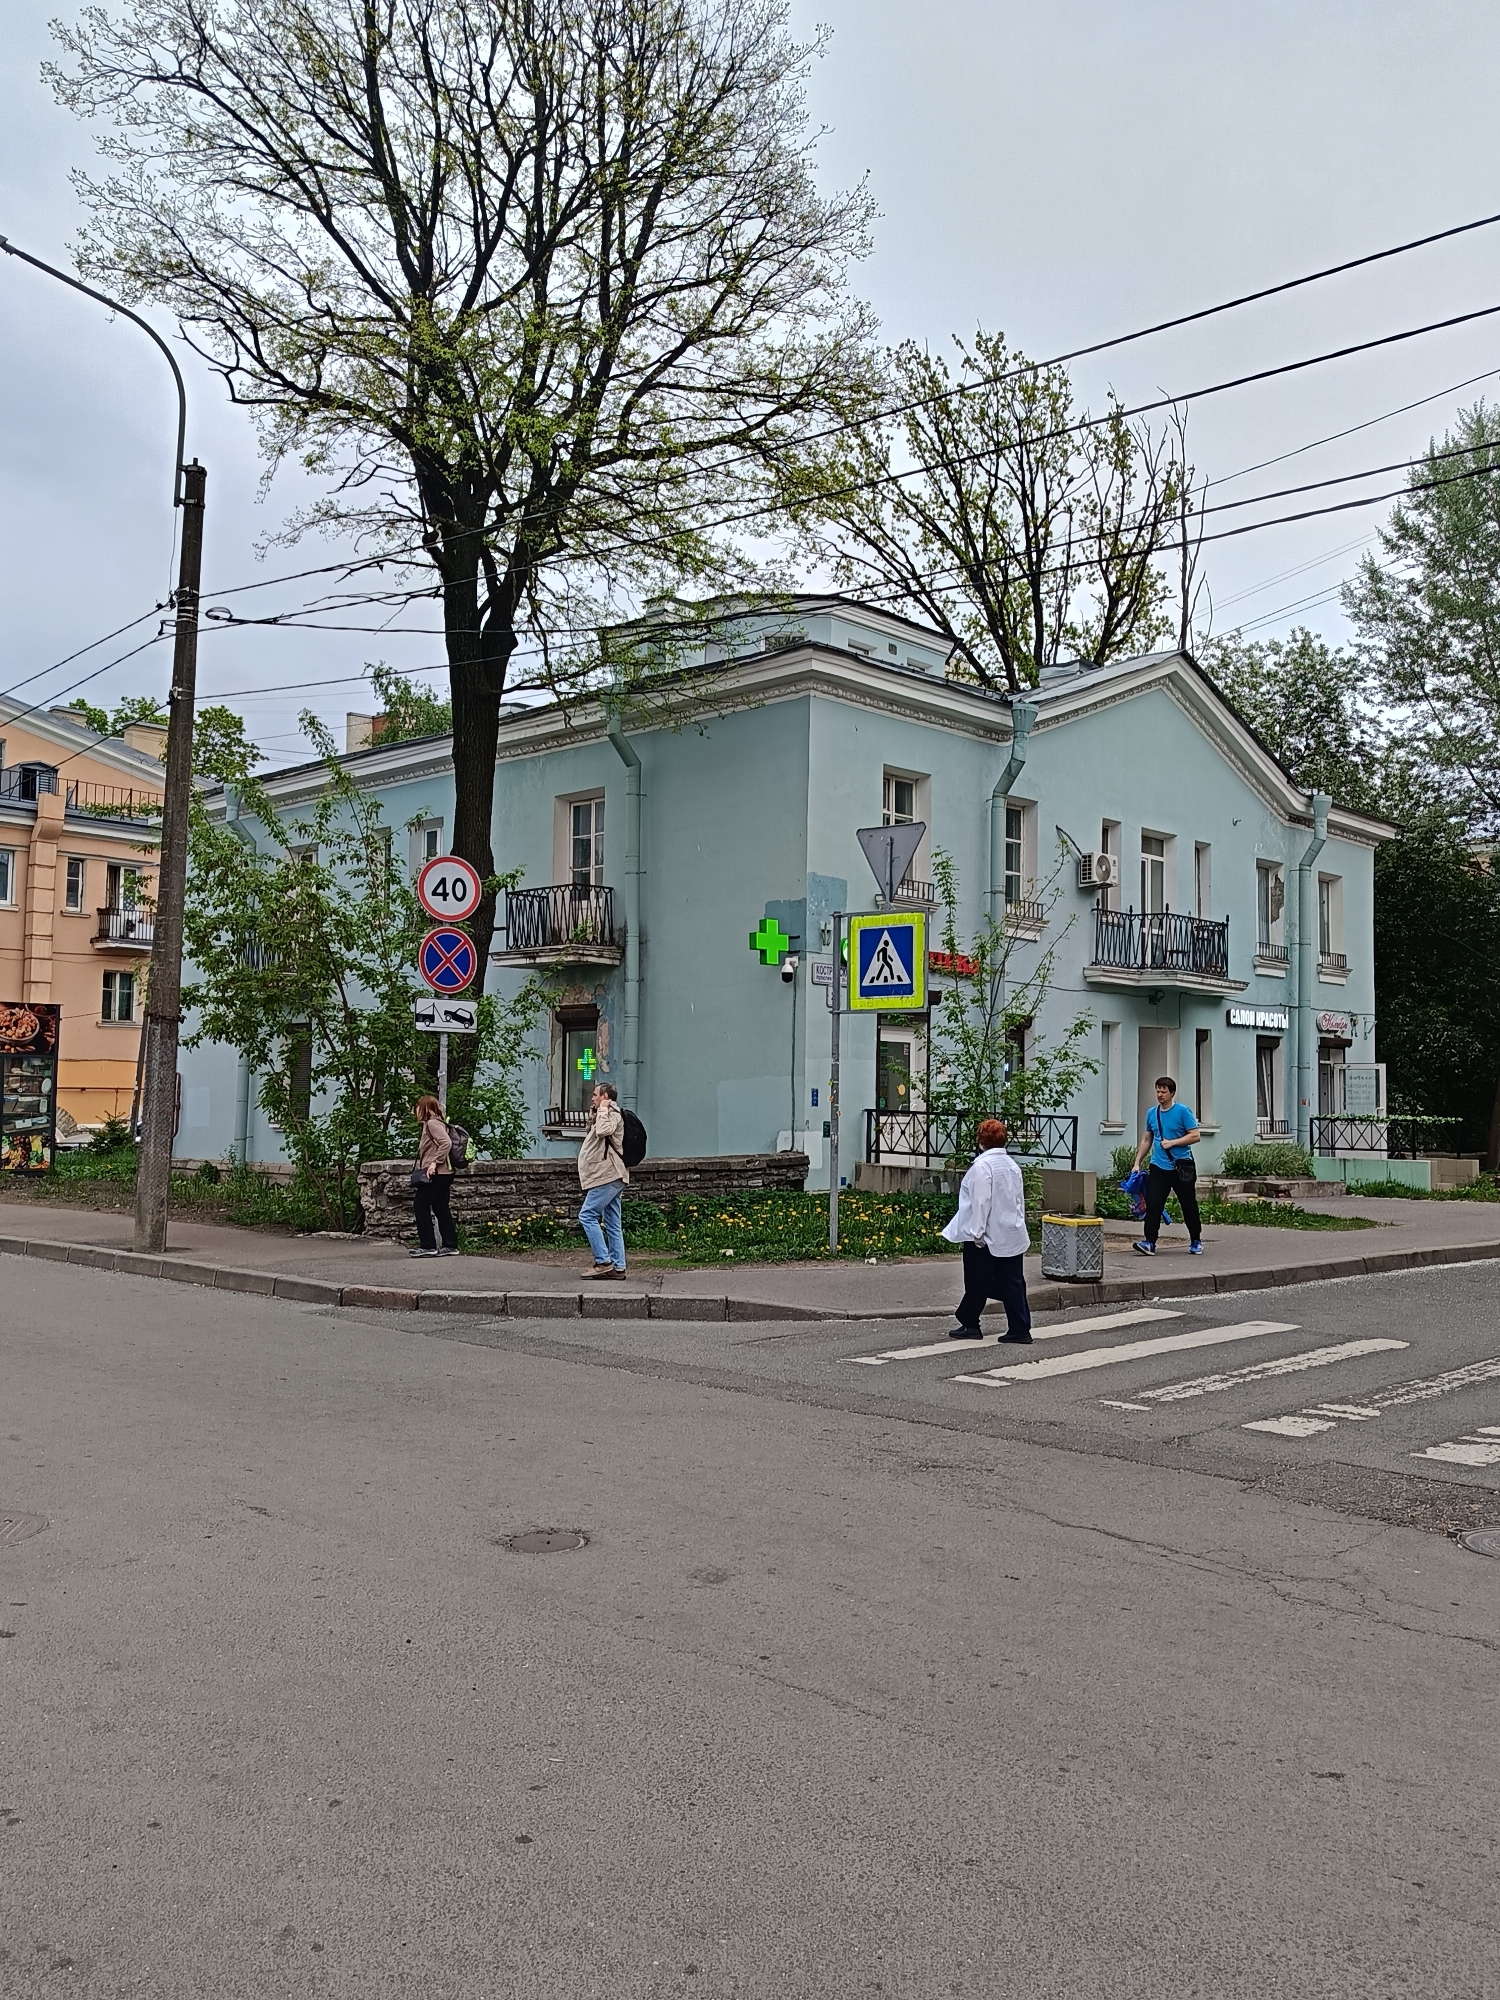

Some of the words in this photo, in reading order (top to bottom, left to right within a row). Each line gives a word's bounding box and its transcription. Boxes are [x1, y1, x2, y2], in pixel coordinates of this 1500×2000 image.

[431, 877, 467, 902] 40
[1230, 1008, 1255, 1026] САЛОН
[1256, 1011, 1289, 1029] КРАСОТЫ
